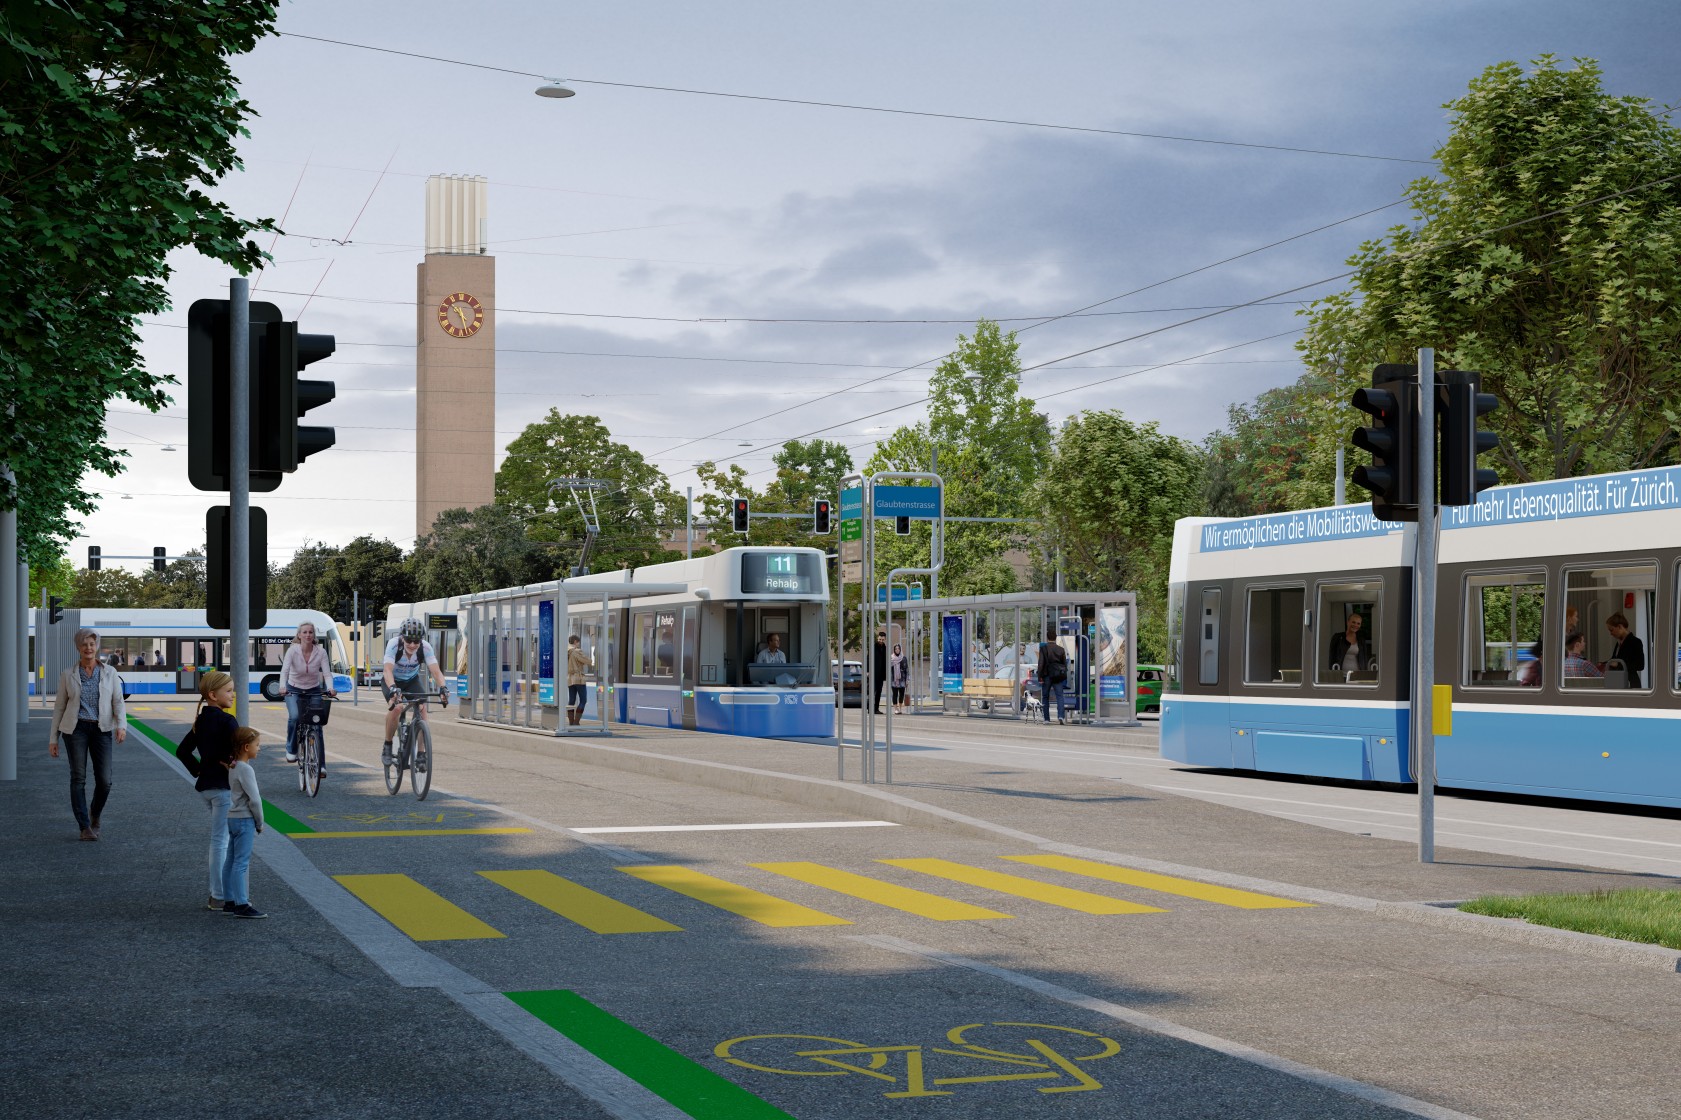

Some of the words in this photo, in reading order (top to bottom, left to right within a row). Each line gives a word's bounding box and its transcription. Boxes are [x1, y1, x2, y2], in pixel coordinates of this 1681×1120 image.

[875, 499, 936, 509] Glaubtenstrasse
[1205, 525, 1220, 548] Wir
[1223, 518, 1286, 549] ermöglichen
[1288, 515, 1305, 540] die
[1473, 491, 1504, 522] mehr
[1506, 482, 1603, 522] Lebensqualität.
[1606, 479, 1628, 510] Für
[1630, 472, 1679, 507] Zürich.
[774, 556, 791, 572] 11
[766, 578, 799, 591] Rehalp
[660, 614, 675, 628] Rehalp
